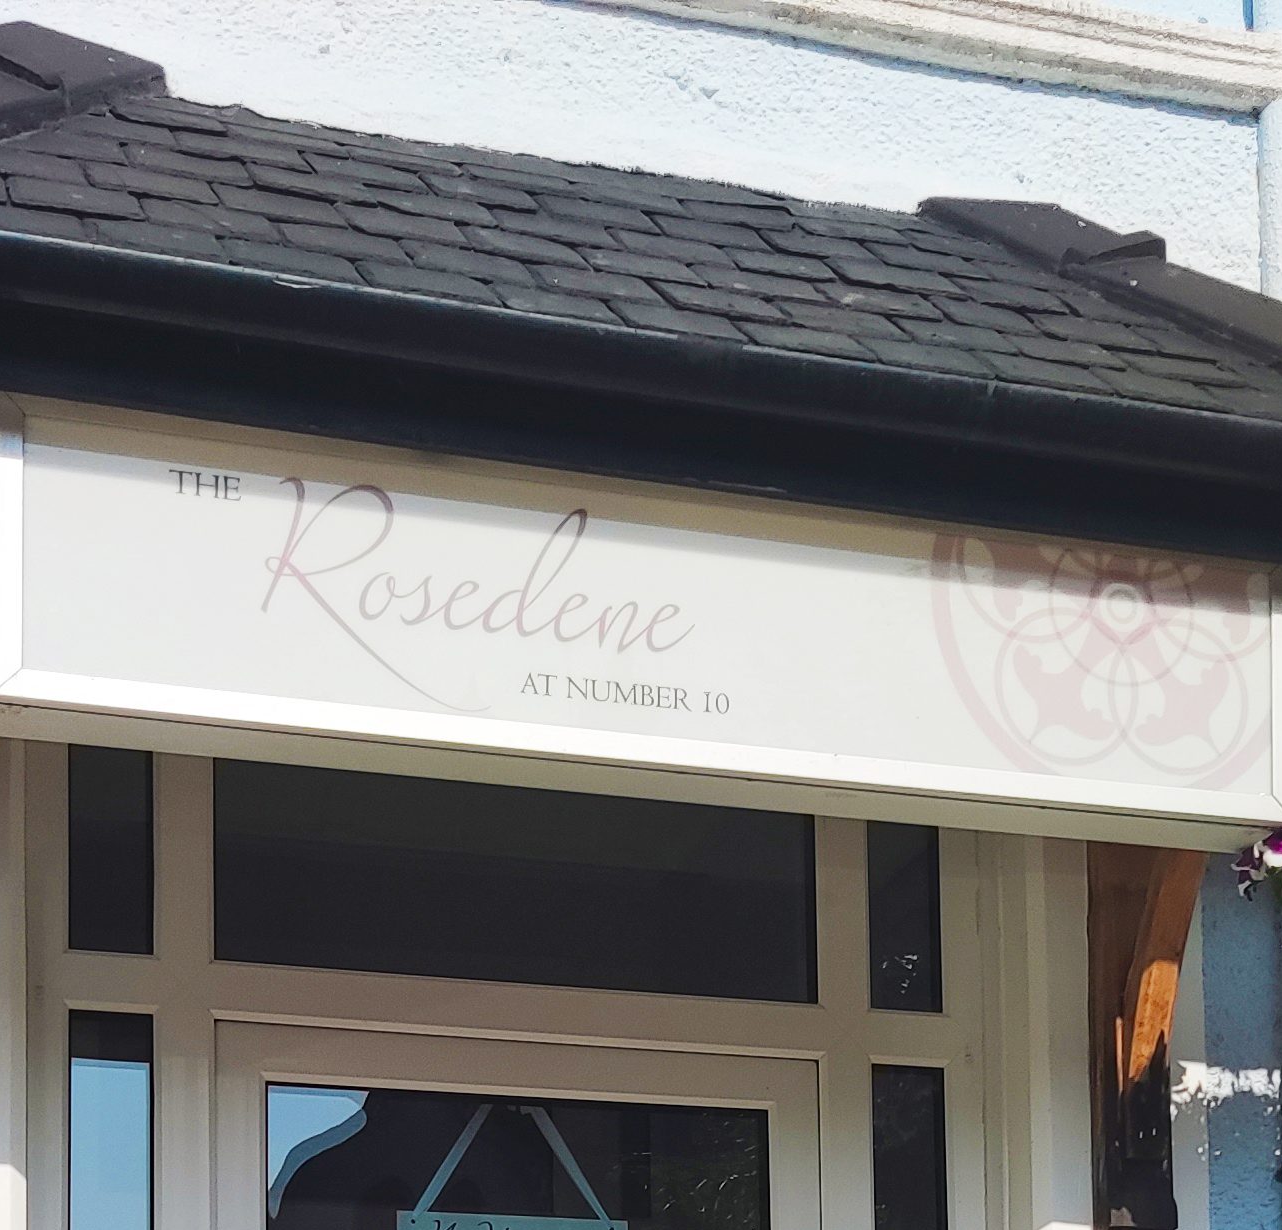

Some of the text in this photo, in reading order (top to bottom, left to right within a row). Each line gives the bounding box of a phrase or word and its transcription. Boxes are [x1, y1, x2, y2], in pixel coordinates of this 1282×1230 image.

[170, 469, 241, 502] THE
[261, 477, 695, 711] Rosedene
[520, 672, 731, 715] AT NUMBER 10
